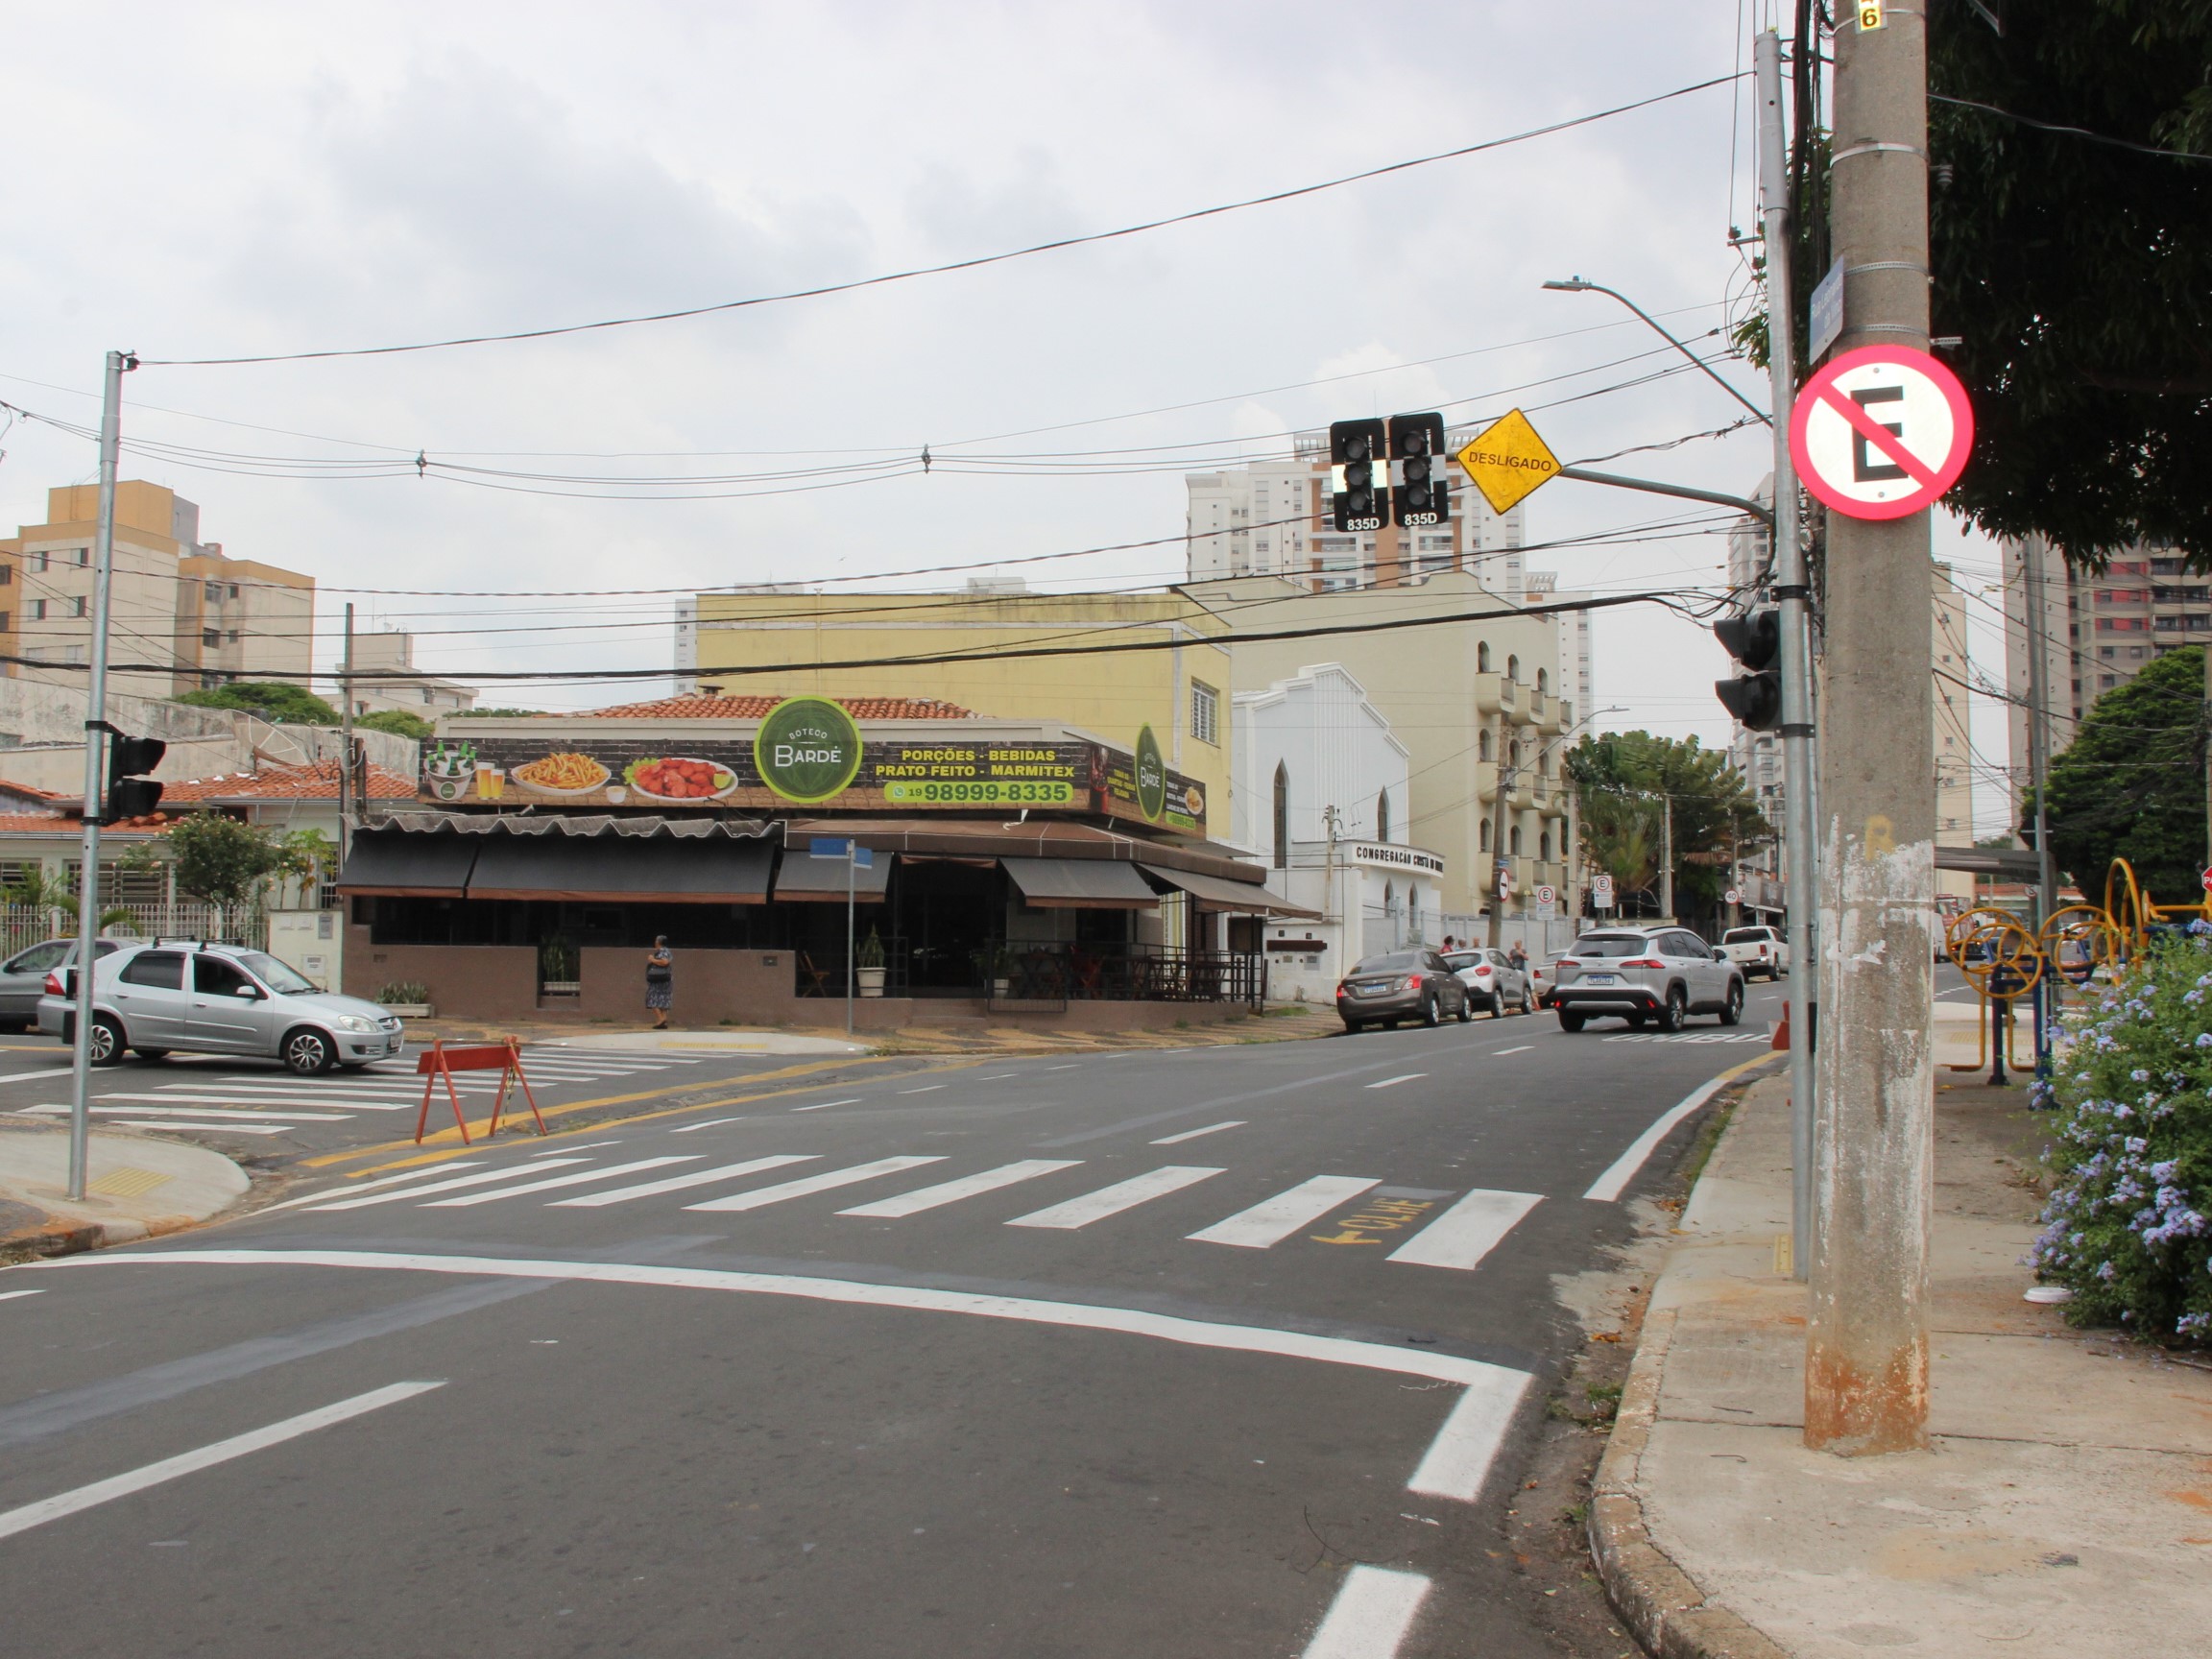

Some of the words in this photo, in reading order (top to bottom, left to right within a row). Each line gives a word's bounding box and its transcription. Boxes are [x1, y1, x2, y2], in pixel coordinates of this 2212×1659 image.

[1861, 0, 1878, 28] 6
[1850, 385, 1910, 482] E
[1468, 451, 1551, 471] DESLIGADO
[1347, 517, 1380, 531] 835D
[1405, 512, 1437, 526] 835D
[788, 728, 828, 739] BOTECO
[902, 748, 975, 763] PORÇÕES
[988, 750, 1056, 761] BEBIDAS
[875, 765, 926, 776] PRATO
[930, 765, 975, 777] FEITO
[991, 765, 1074, 777] MARMITEX
[908, 788, 923, 797] 19
[925, 783, 1068, 801] 98999-8335
[1599, 879, 1606, 888] E
[1543, 890, 1549, 900] E
